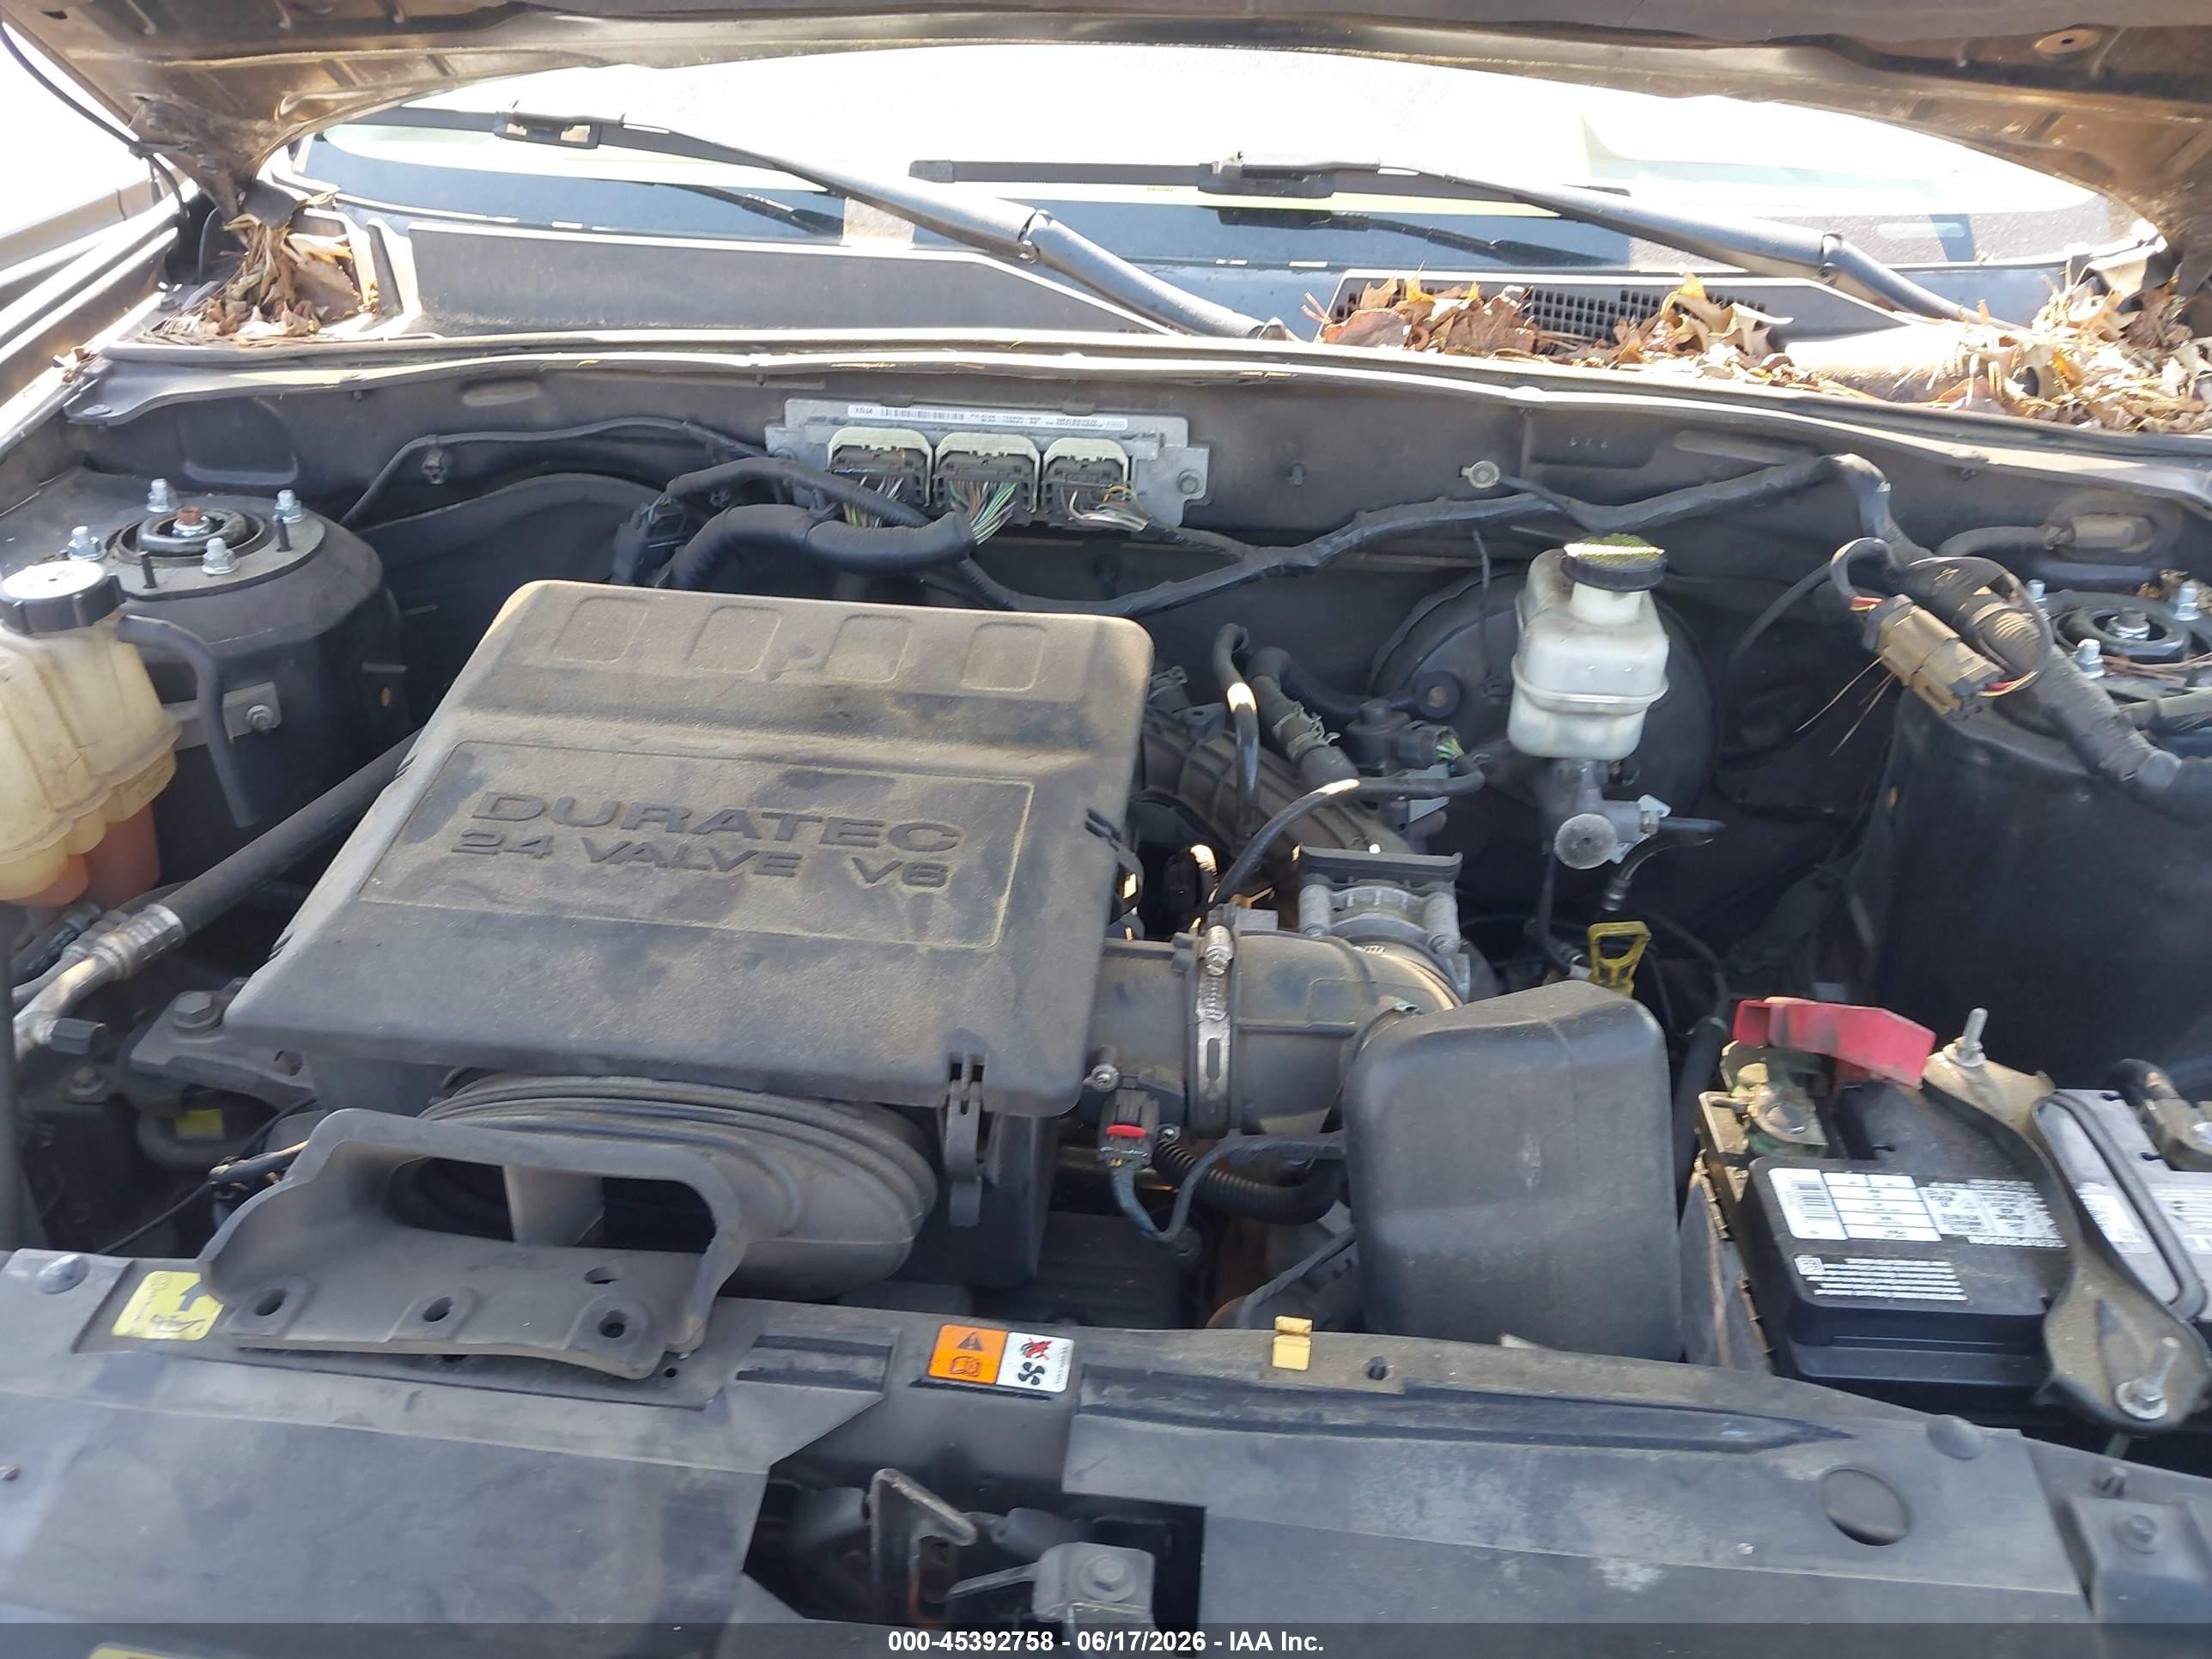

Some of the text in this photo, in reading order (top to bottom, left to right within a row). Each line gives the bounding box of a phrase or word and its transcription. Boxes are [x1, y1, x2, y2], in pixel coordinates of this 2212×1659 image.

[471, 791, 960, 853] DURATEC
[450, 828, 950, 888] 24 VALVE V6
